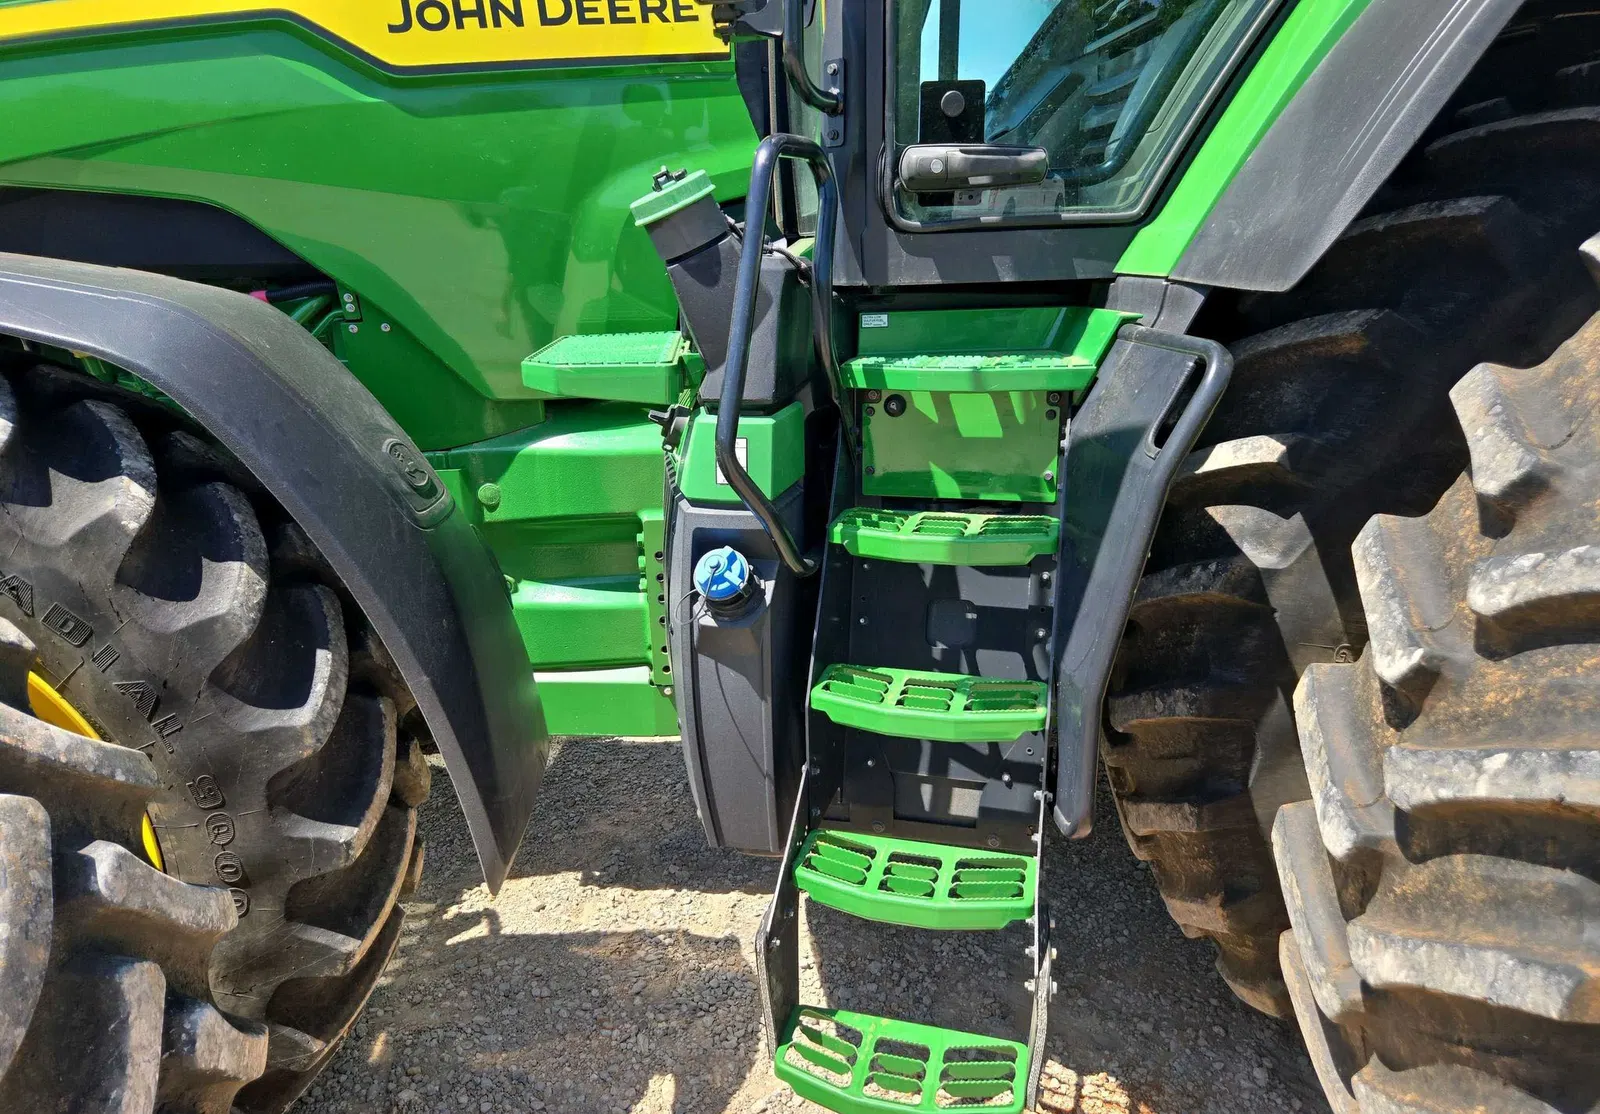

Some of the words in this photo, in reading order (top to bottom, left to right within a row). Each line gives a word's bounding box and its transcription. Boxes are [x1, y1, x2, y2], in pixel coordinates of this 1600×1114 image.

[387, 0, 525, 33] JOHN
[537, 0, 699, 26] DEERE
[0, 571, 184, 753] ADIAL
